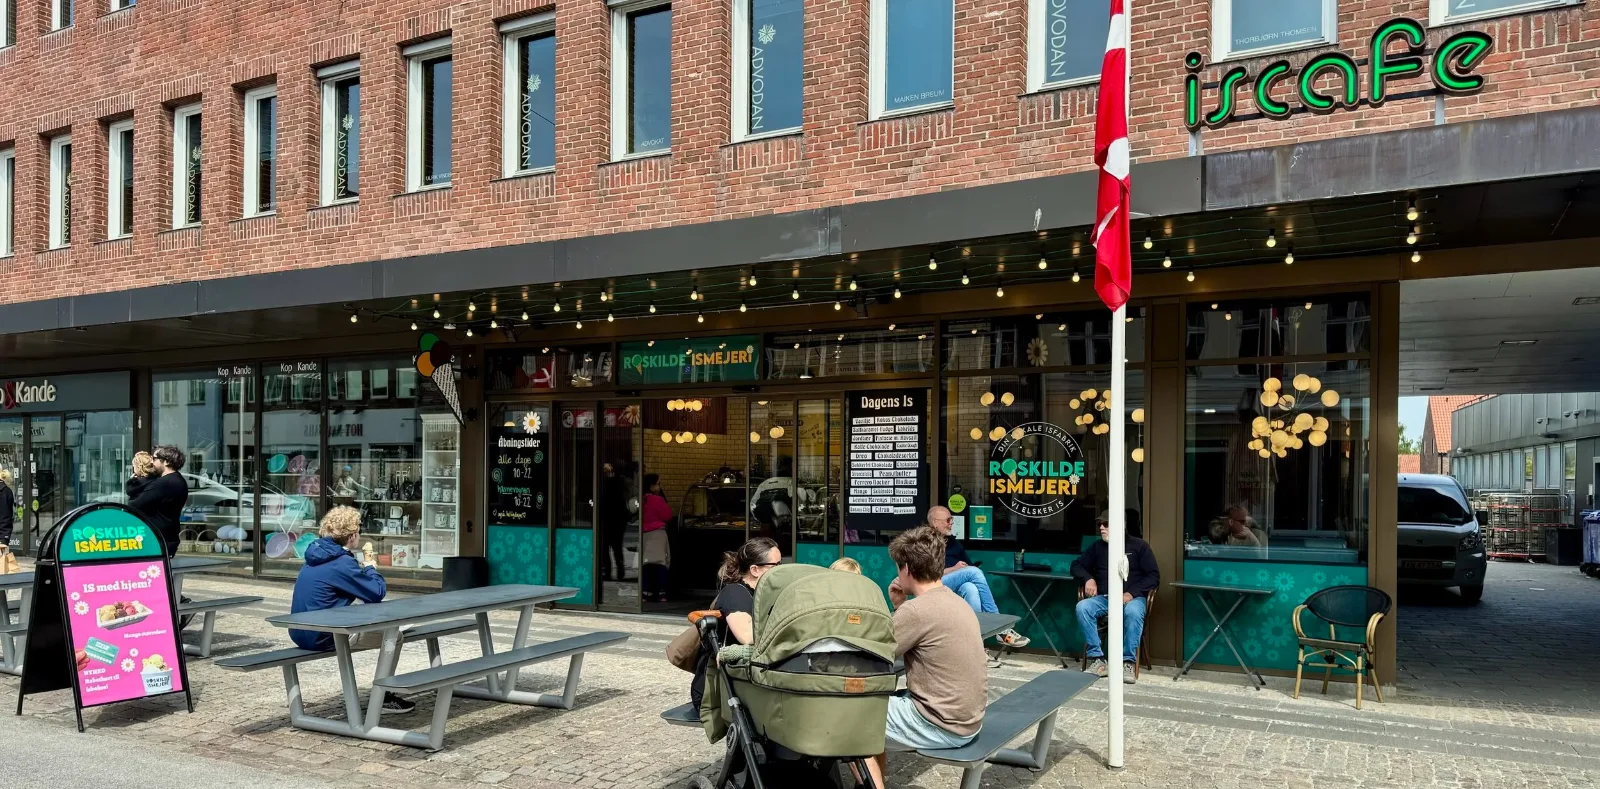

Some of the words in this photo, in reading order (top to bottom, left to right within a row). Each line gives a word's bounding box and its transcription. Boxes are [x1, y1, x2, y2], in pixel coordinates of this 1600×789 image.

[1051, 0, 1067, 77] DVODAN
[1235, 30, 1279, 45] THORBJØRN
[1280, 26, 1317, 38] THOMSEN
[751, 46, 764, 130] ADVODAN
[894, 93, 919, 104] MAIKEN
[921, 89, 945, 100] BREUM
[521, 93, 532, 167] ADVODAN
[640, 137, 665, 147] ADVOKAT
[338, 130, 347, 197] ADVODAN
[188, 161, 197, 222] ADVODAN
[280, 363, 293, 374] Kop
[297, 361, 317, 372] Kande
[623, 354, 686, 370] ROSKILDE
[691, 350, 753, 366] ISMEJERI
[217, 367, 229, 378] Kop
[233, 365, 251, 375] Kande
[15, 379, 57, 404] Kande
[861, 396, 900, 410] Dagens
[903, 395, 914, 407] Is
[498, 436, 541, 449] Åbningstider
[998, 438, 1011, 453] DIN
[1045, 426, 1077, 453] ISFABRIK
[497, 454, 512, 465] alle
[515, 454, 532, 468] dage
[989, 459, 1085, 477] ROSKILDE
[513, 467, 532, 479] 10-22
[989, 477, 1077, 495] ISMEJERI
[514, 496, 532, 508] 10-22
[1011, 501, 1020, 510] VI
[1021, 503, 1054, 515] ELSKER
[1056, 501, 1065, 510] IS
[72, 526, 146, 541] ROSKILDE
[8, 538, 20, 546] ande
[74, 537, 143, 554] ISMEJERI
[82, 583, 96, 594] IS
[97, 580, 120, 592] med
[121, 578, 152, 592] hjem?
